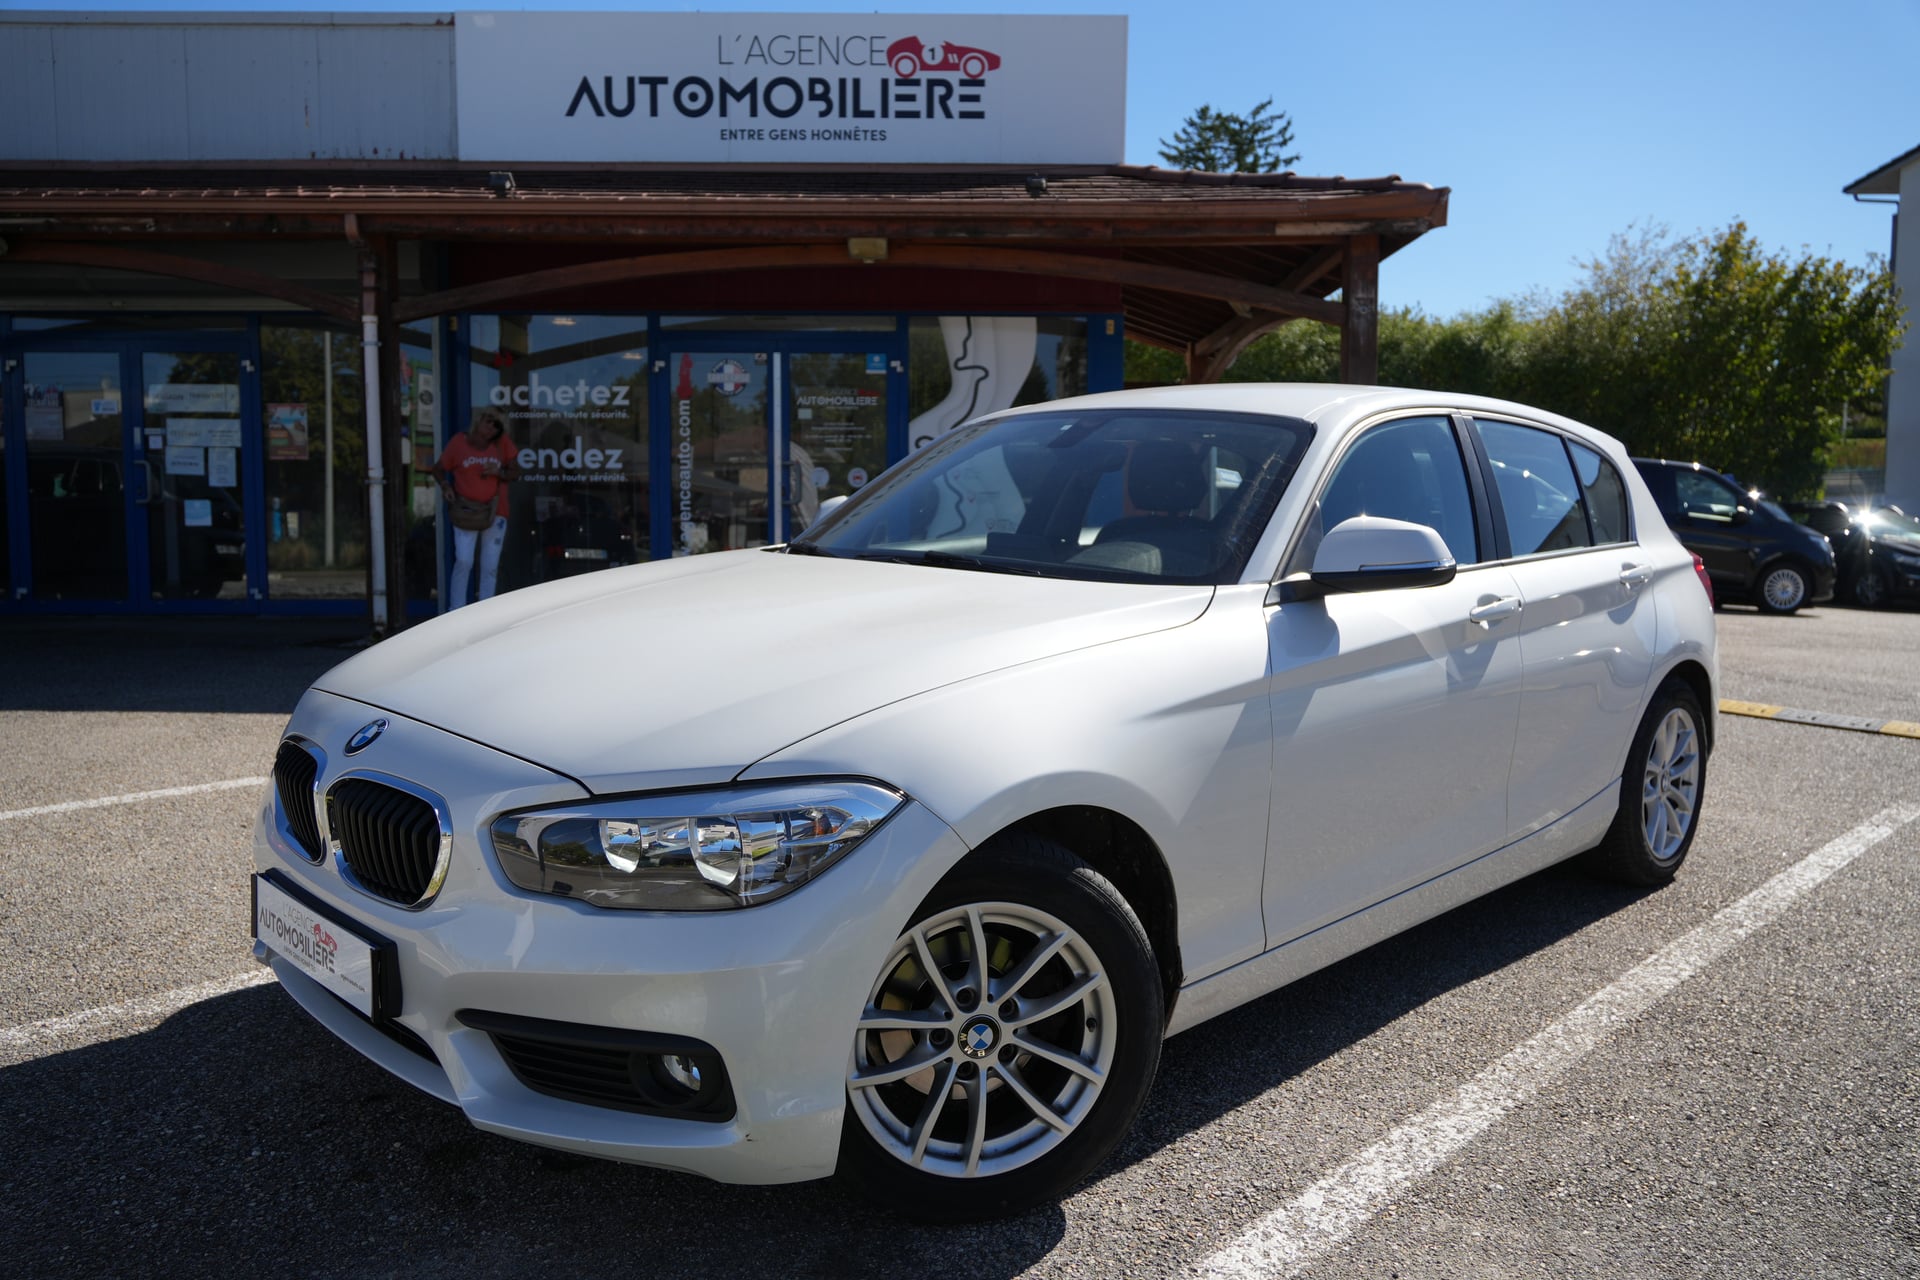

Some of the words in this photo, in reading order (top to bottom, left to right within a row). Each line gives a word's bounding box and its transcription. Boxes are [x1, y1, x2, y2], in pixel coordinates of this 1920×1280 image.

[719, 128, 765, 142] ENTRE
[768, 129, 807, 142] GENS
[810, 125, 888, 142] HONNÊTES
[489, 372, 631, 407] achetez
[549, 412, 562, 420] en
[563, 410, 589, 420] toute
[591, 408, 631, 420] sécurité.
[516, 435, 624, 470] endez
[524, 473, 546, 483] auto
[548, 474, 561, 483] en
[562, 473, 588, 483] toute
